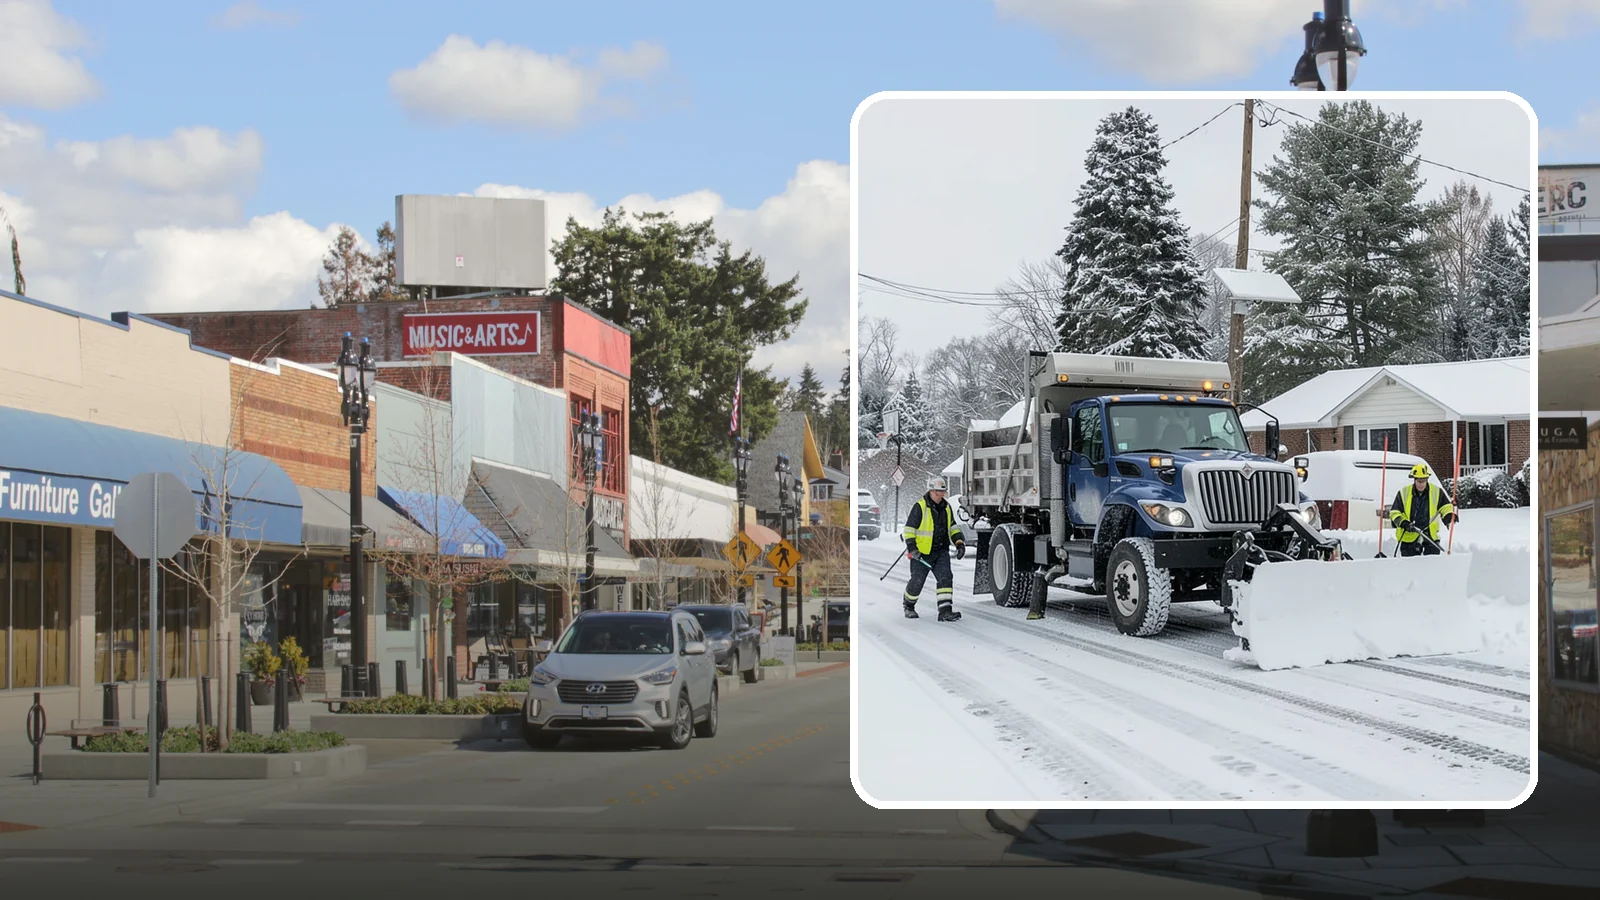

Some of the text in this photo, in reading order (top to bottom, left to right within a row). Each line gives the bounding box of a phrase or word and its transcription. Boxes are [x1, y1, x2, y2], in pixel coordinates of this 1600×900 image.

[0, 472, 121, 518] Furniture Gal
[453, 562, 480, 574] SUSHI
